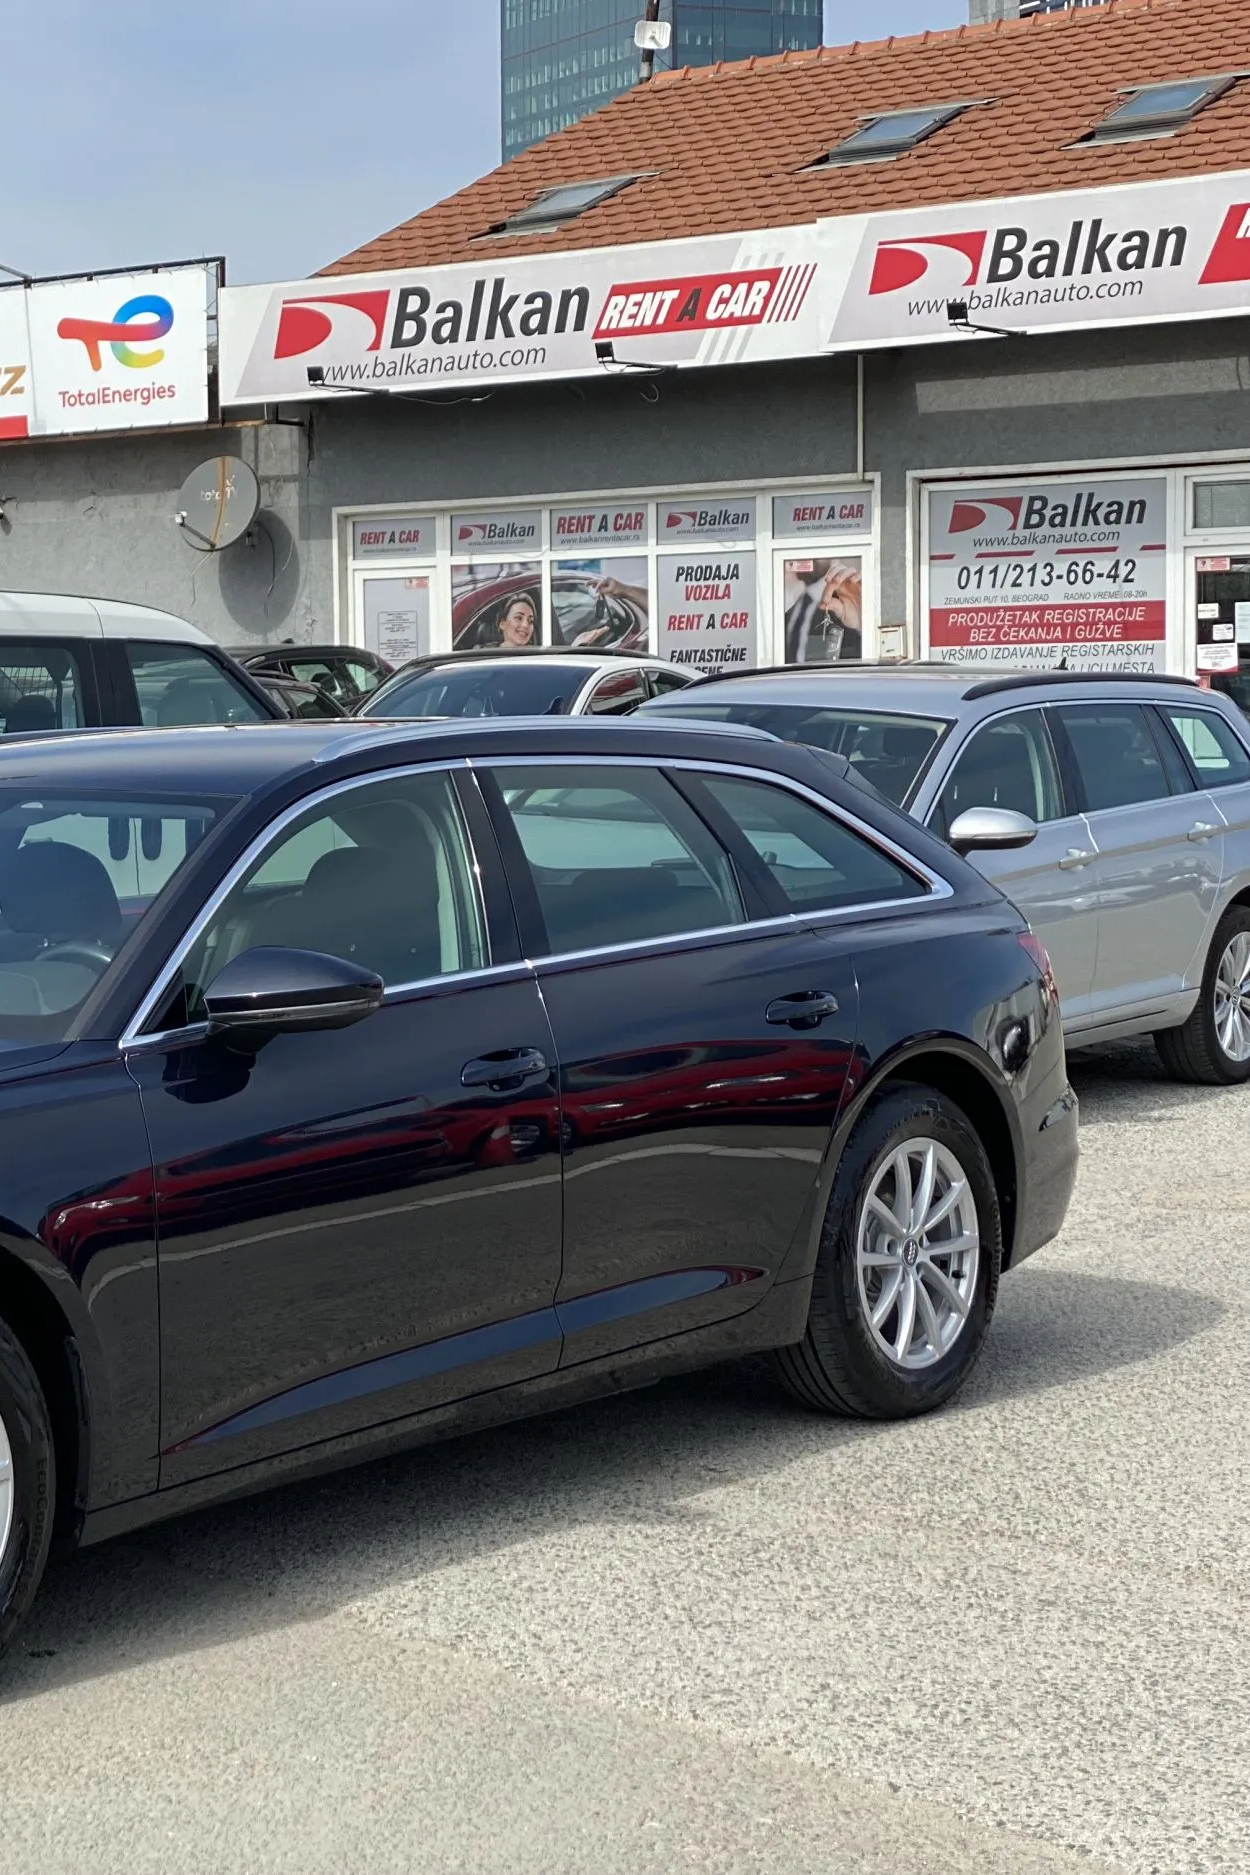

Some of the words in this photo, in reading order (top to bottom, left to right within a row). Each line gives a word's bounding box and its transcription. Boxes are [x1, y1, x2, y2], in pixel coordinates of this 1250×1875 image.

[986, 218, 1188, 284] Balkan
[908, 278, 1144, 316] wwbalkanauto.com
[390, 276, 590, 349] Balkan
[599, 288, 681, 331] RENT
[676, 286, 702, 322] A
[703, 280, 772, 321] CAR
[323, 347, 546, 382] ww.balkanauto.com
[59, 381, 176, 408] TotalEnergies
[698, 509, 750, 527] Balkan
[793, 506, 825, 522] RENT
[826, 505, 835, 520] A
[839, 503, 864, 519] CAR
[1023, 492, 1147, 530] Balkan
[488, 522, 535, 539] Balkan
[556, 514, 596, 534] RENT
[597, 513, 609, 533] A
[613, 511, 645, 532] CAR
[360, 531, 386, 545] RENT
[387, 530, 396, 544] A
[398, 529, 421, 544] CAR
[973, 530, 1120, 548] www.balkanauto.com
[675, 563, 740, 582] PRODAJA
[957, 558, 1137, 590] 011/213-66-42
[685, 583, 732, 601] VOZILA
[983, 595, 999, 605] PUT
[1012, 593, 1049, 603] BEOGRAD
[1063, 592, 1091, 601] RADNO
[667, 613, 704, 632] RENT
[706, 612, 716, 630] A
[720, 611, 749, 630] CAR
[948, 609, 1041, 627] PRODUŽETAK
[1044, 606, 1146, 624] REGISTRACIJE
[970, 628, 996, 642] BEZ
[1000, 624, 1062, 641] ČEKANJA
[1075, 621, 1123, 639] GUŽVE
[670, 643, 747, 664] FANTASTIČNE
[941, 645, 988, 661] VRŠIMO
[991, 645, 1058, 660] IZDAVANJE
[1061, 642, 1155, 657] REGISTARSKIH
